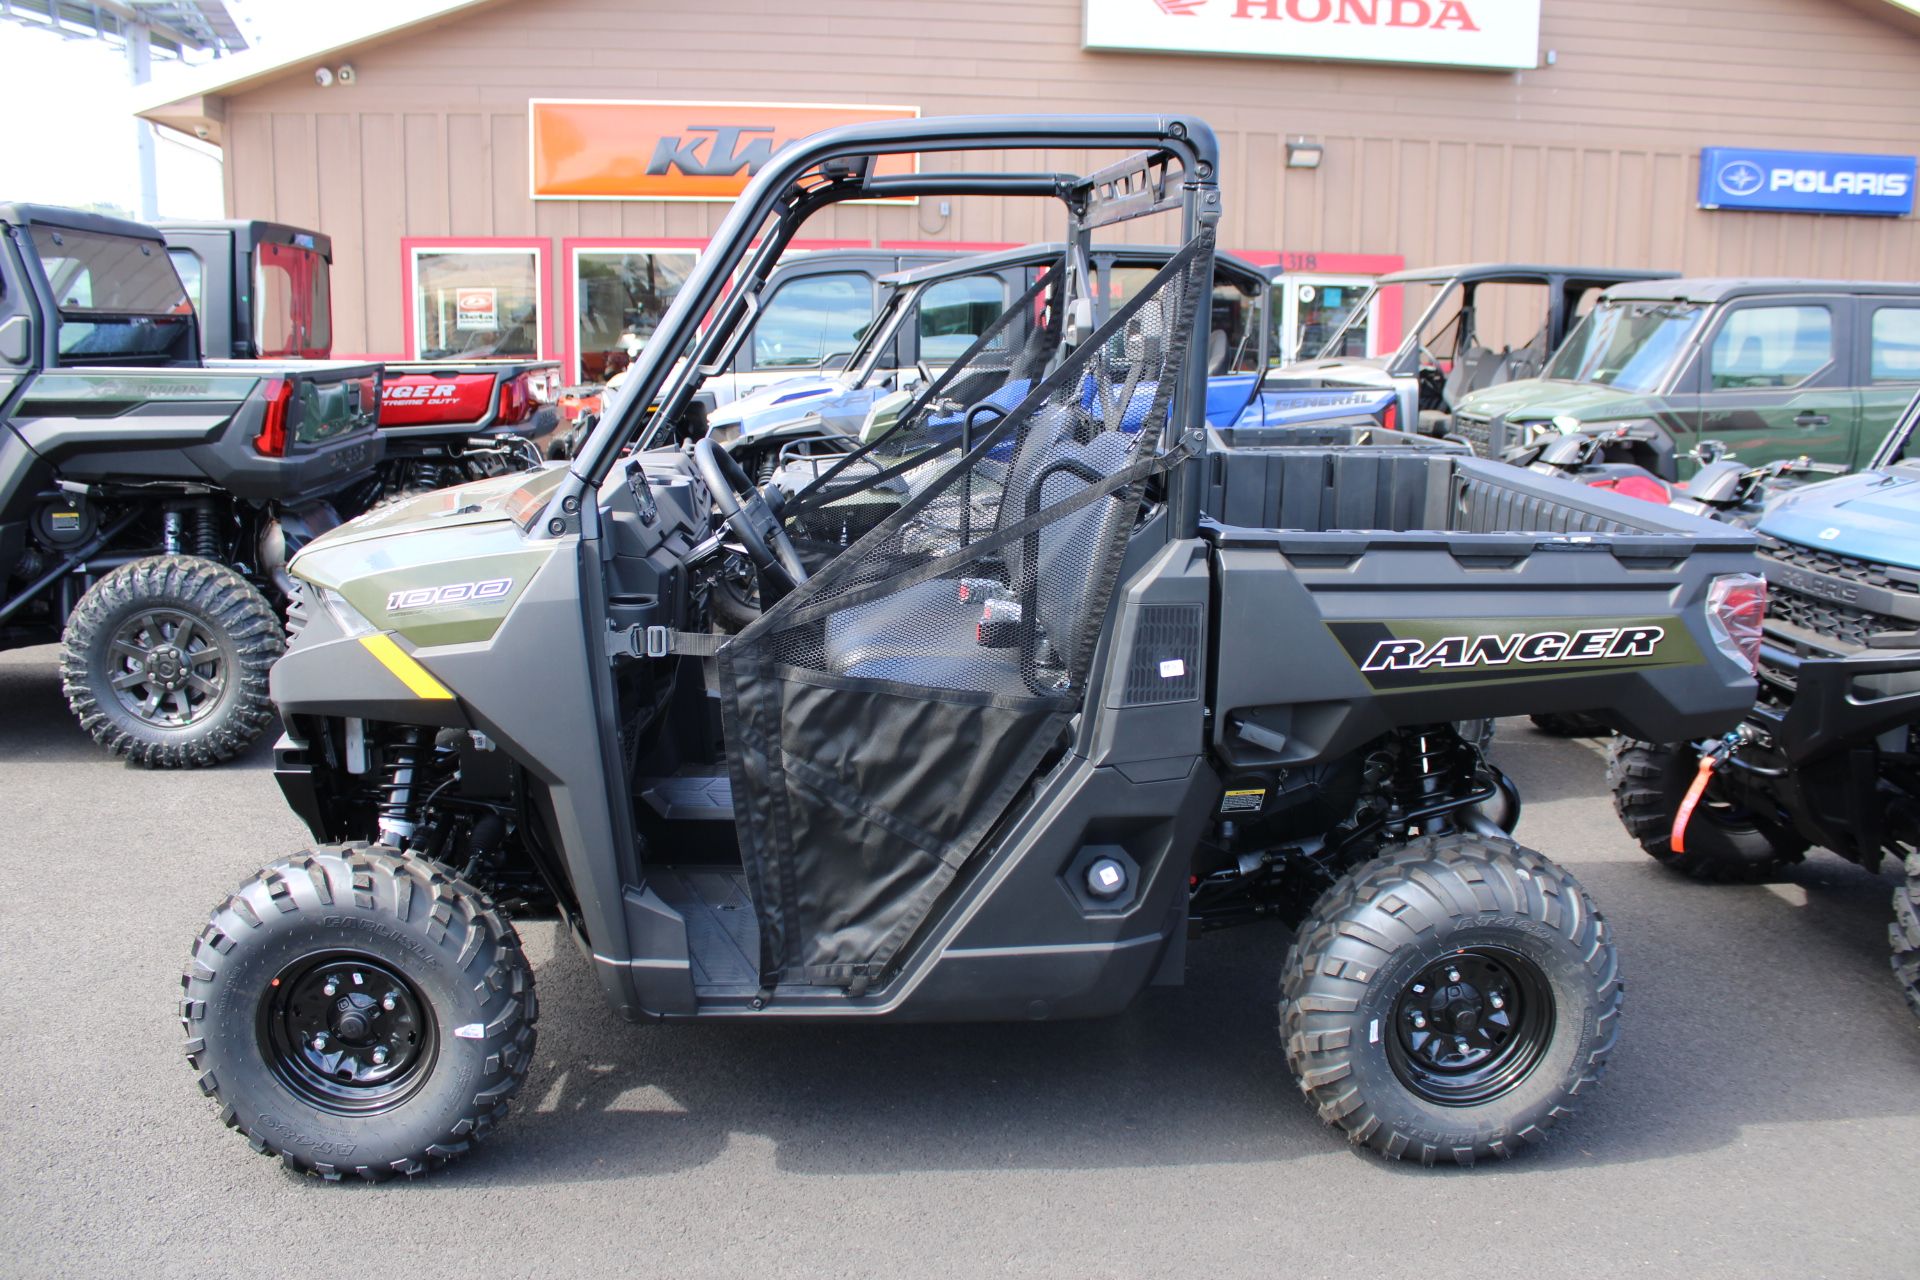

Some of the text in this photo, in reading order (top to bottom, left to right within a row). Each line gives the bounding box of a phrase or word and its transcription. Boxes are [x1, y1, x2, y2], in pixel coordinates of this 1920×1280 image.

[1230, 0, 1481, 32] HONDA
[645, 125, 800, 176] KTM
[1769, 168, 1908, 197] POLARIS
[1273, 393, 1373, 411] GENERAL
[386, 577, 513, 611] 1000
[1780, 568, 1859, 604] POLARIS
[1361, 625, 1665, 672] RANGER
